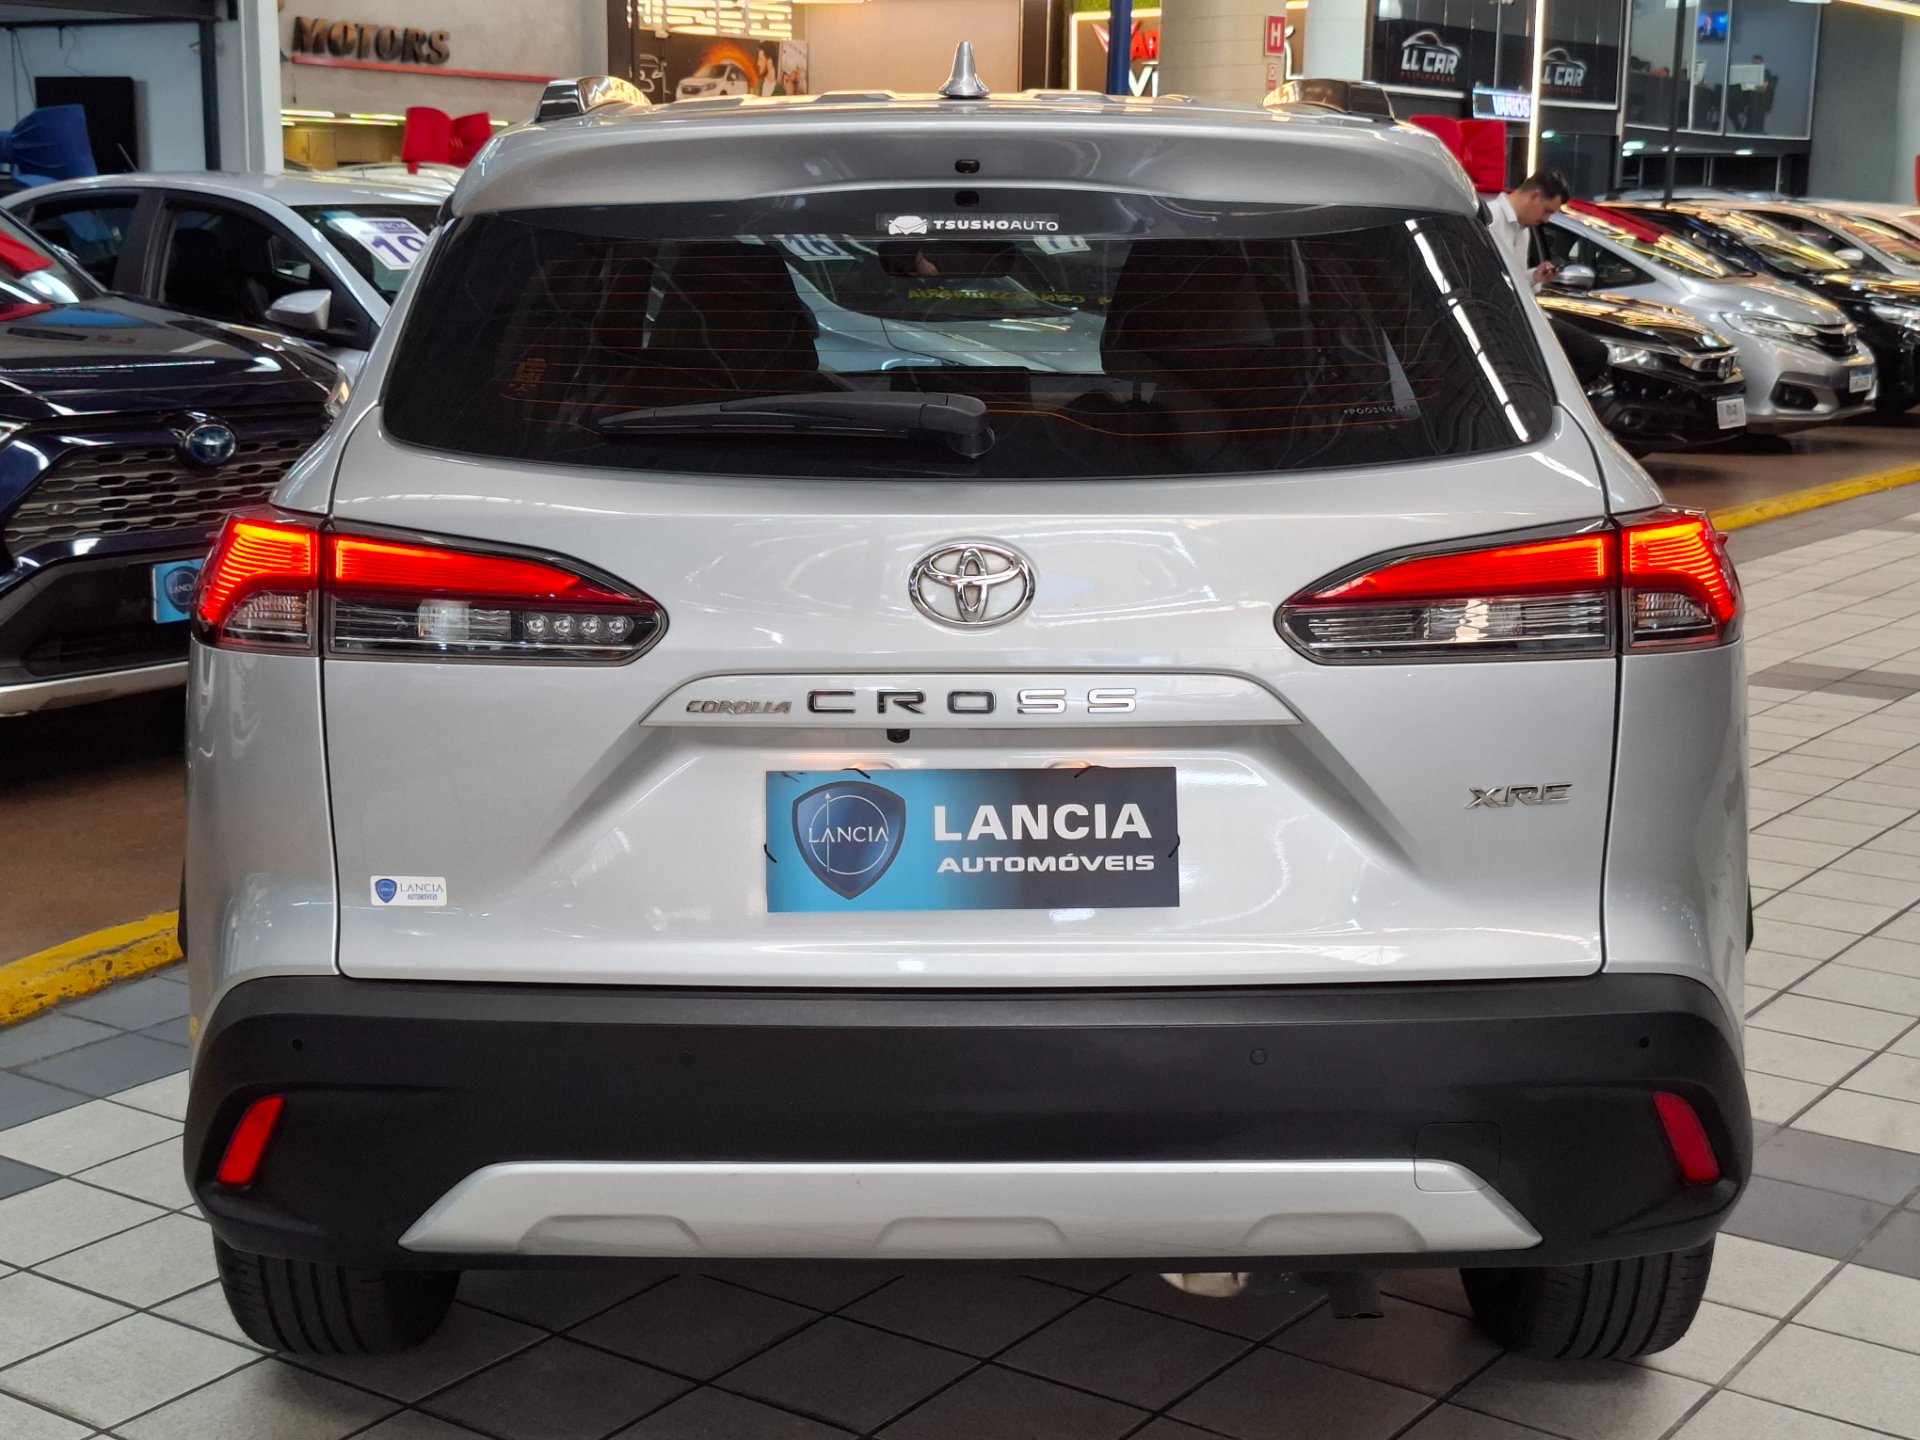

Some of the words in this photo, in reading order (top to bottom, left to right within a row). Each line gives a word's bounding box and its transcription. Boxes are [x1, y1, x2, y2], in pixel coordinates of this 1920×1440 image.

[292, 16, 450, 64] MOTORS
[1270, 22, 1282, 47] H
[1401, 48, 1420, 71] LL
[1422, 51, 1458, 75] CAR
[1554, 66, 1584, 87] CAR
[933, 219, 1059, 232] TSUSHOAUTO
[685, 699, 792, 715] COROLLA
[806, 688, 1137, 715] CROSS
[1464, 782, 1573, 809] XRE
[808, 826, 889, 843] LANCIA
[934, 803, 1152, 841] LANCIA
[936, 853, 1155, 873] AUTOMÓVEIS
[400, 883, 444, 893] LANCIA
